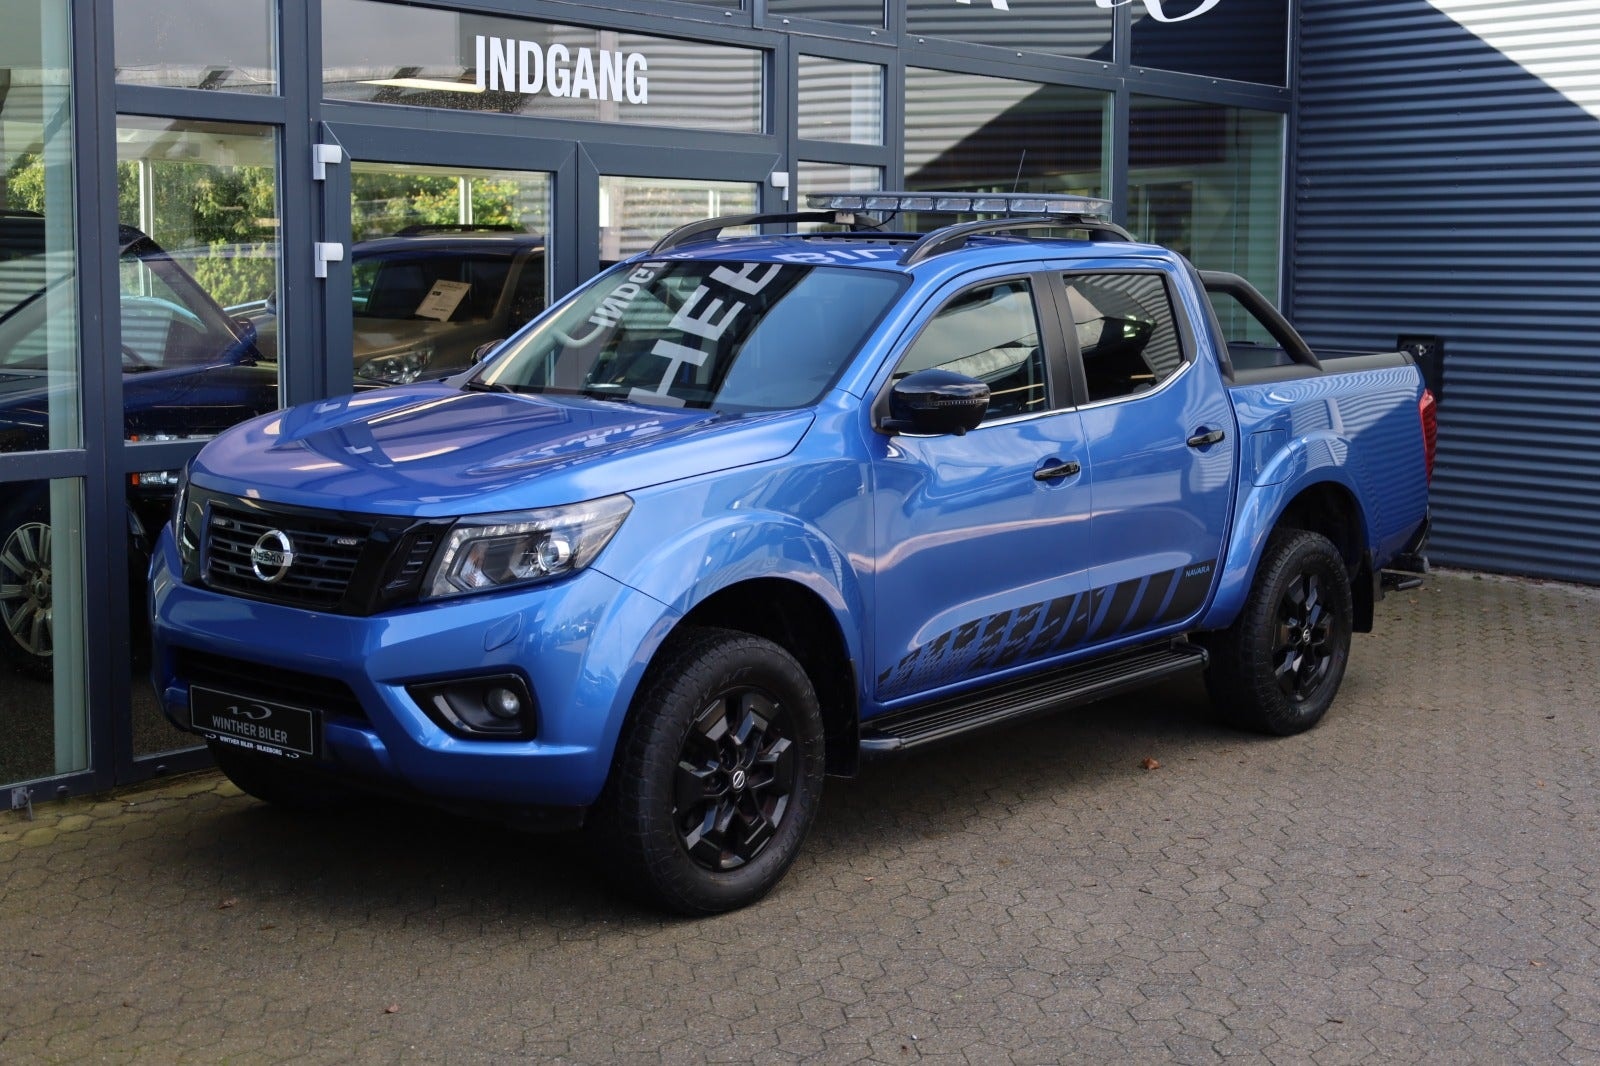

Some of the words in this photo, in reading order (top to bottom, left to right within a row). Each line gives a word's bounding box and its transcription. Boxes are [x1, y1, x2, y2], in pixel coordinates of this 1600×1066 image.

[475, 35, 648, 105] INDGANG
[252, 549, 285, 564] NISSAN
[1186, 565, 1210, 576] NAVARA
[212, 715, 257, 736] WINTHER
[258, 726, 288, 744] BILER
[220, 736, 240, 744] WINTHER
[241, 741, 253, 749] BILER
